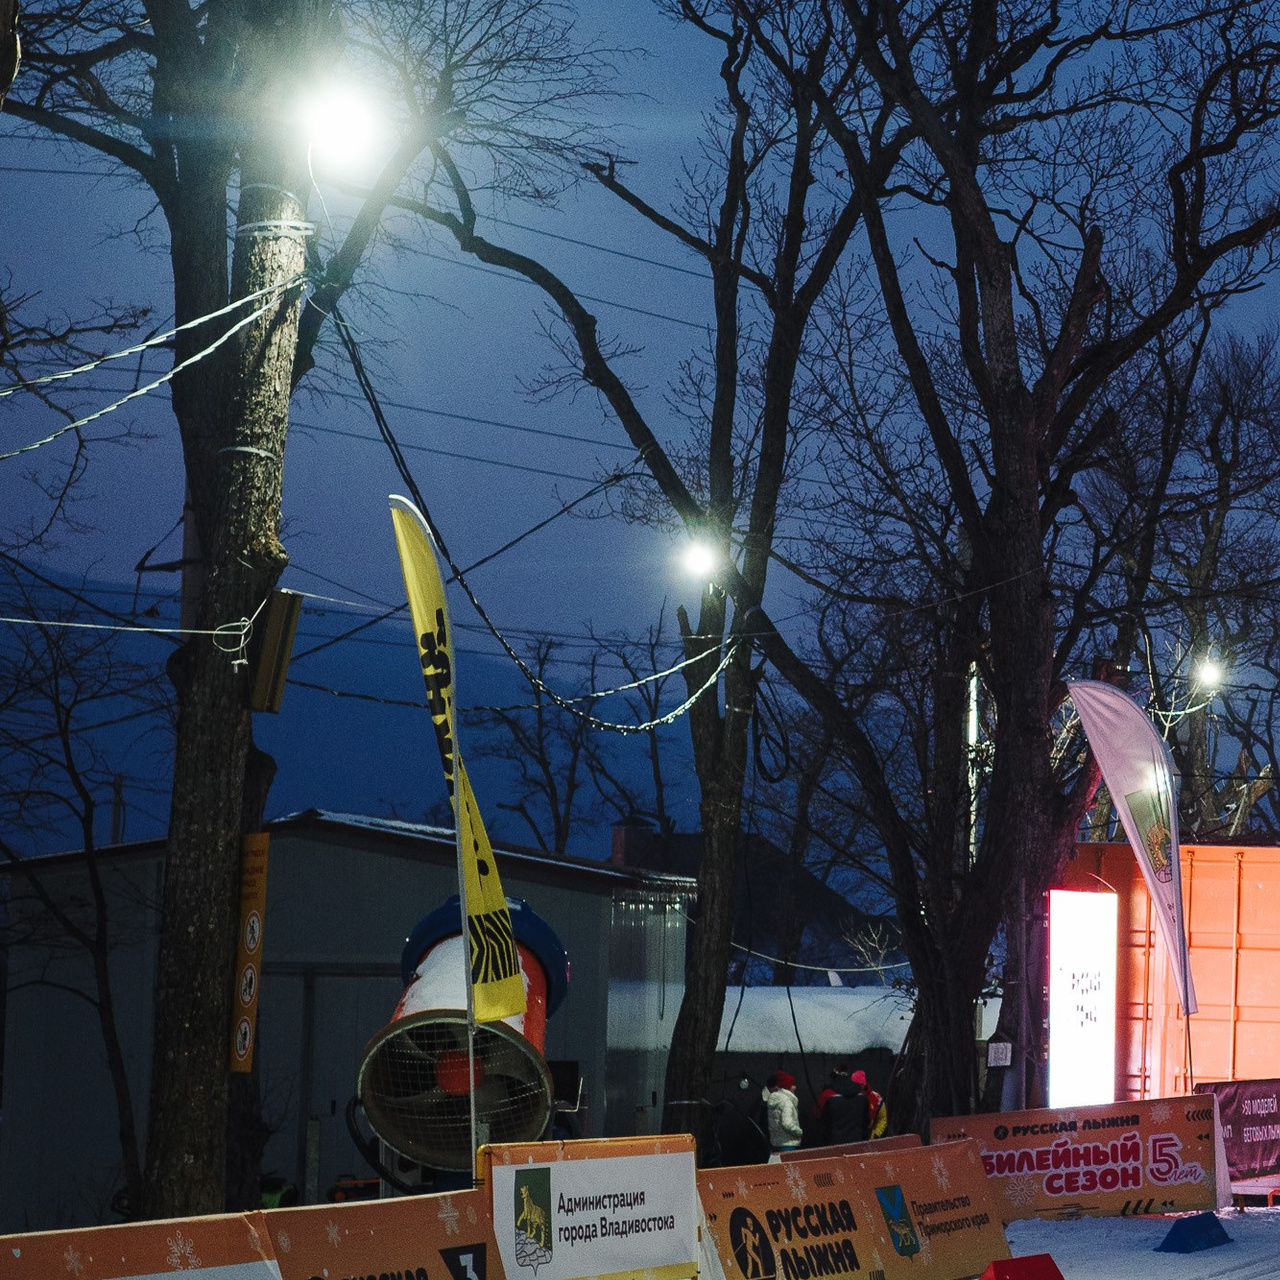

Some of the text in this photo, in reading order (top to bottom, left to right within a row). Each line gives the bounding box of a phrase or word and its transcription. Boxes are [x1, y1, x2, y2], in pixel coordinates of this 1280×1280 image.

[1252, 1094, 1278, 1117] МОДЕЛЕЙ
[1012, 1114, 1140, 1137] РУССКАЯ ЛЫЖНЯ
[981, 1133, 1140, 1176] БИЛЕЙНЫЙ
[1150, 1136, 1179, 1182] 5
[1045, 1166, 1140, 1194] СЕЗОН
[558, 1191, 645, 1216] Администрация
[910, 1195, 971, 1219] Правительство
[558, 1215, 675, 1246] города Владивостока
[765, 1199, 857, 1243] РУССКАЯ
[917, 1212, 990, 1240] Приморского края
